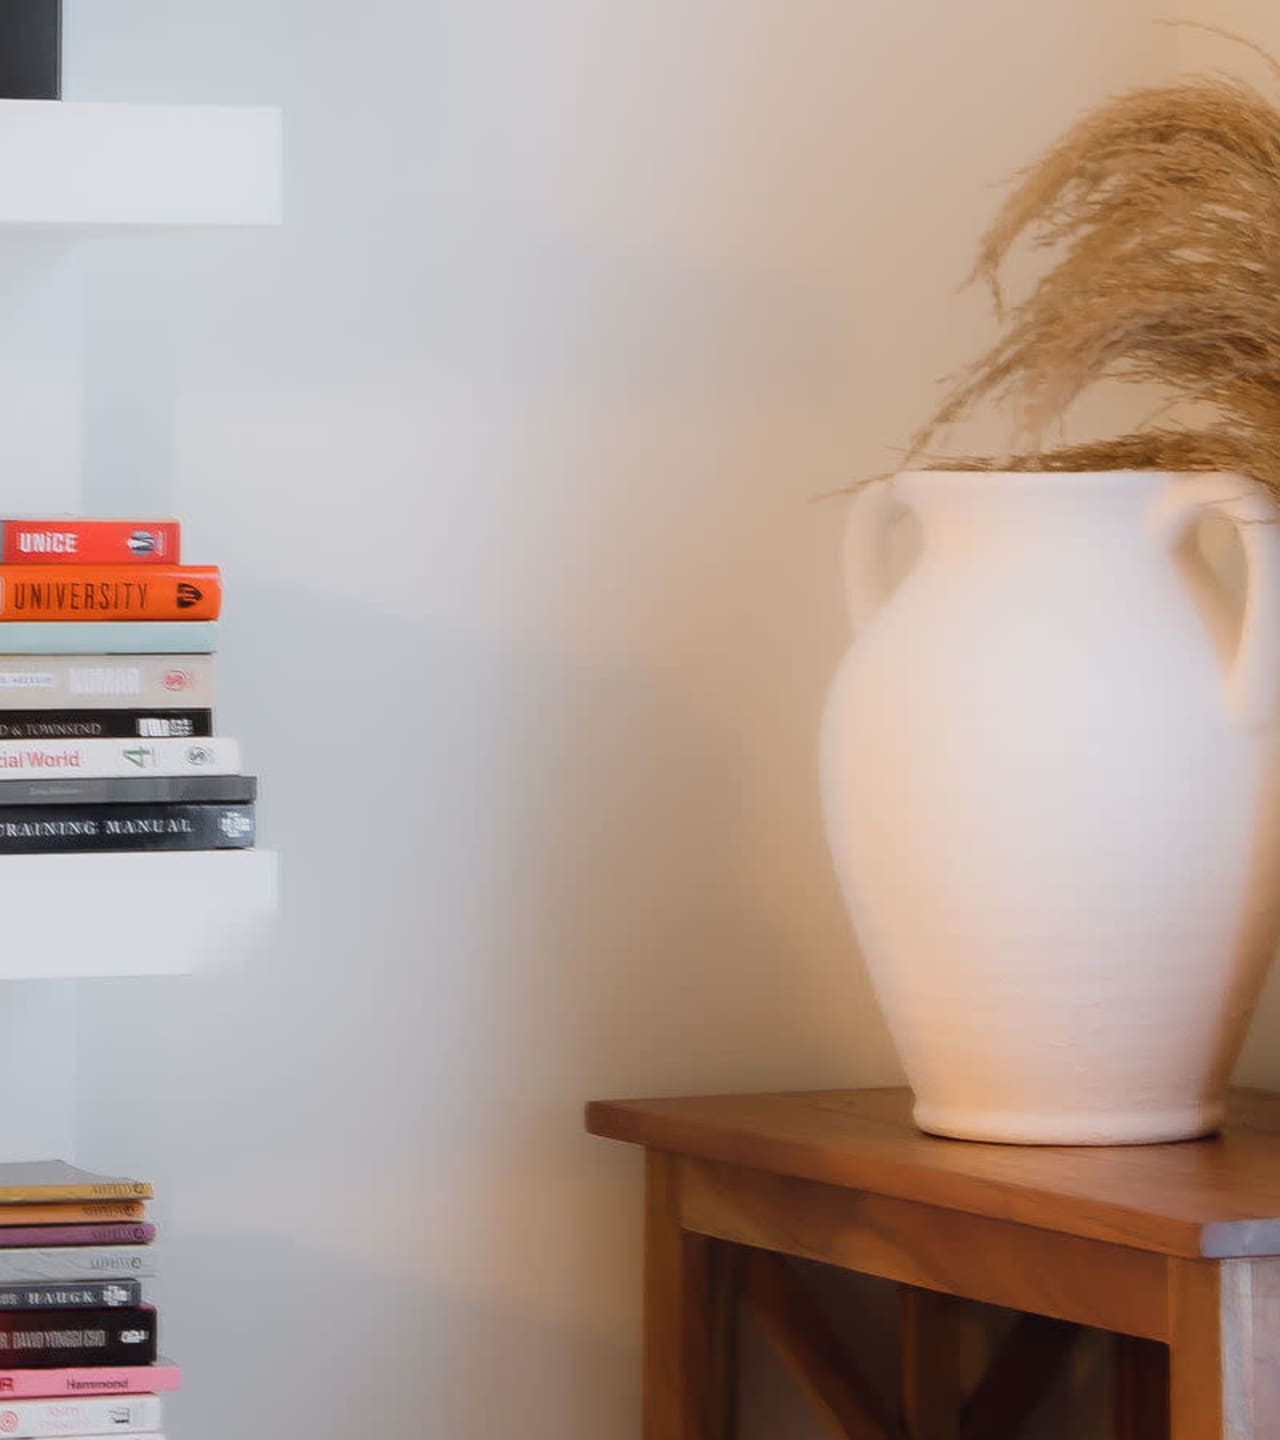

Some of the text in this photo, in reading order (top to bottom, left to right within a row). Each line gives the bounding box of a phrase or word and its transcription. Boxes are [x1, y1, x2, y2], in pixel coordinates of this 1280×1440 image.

[13, 582, 148, 611] UNIVERSITY
[104, 817, 194, 835] MANUAL
[26, 1291, 97, 1305] HAUGK
[66, 1378, 129, 1391] Hammond
